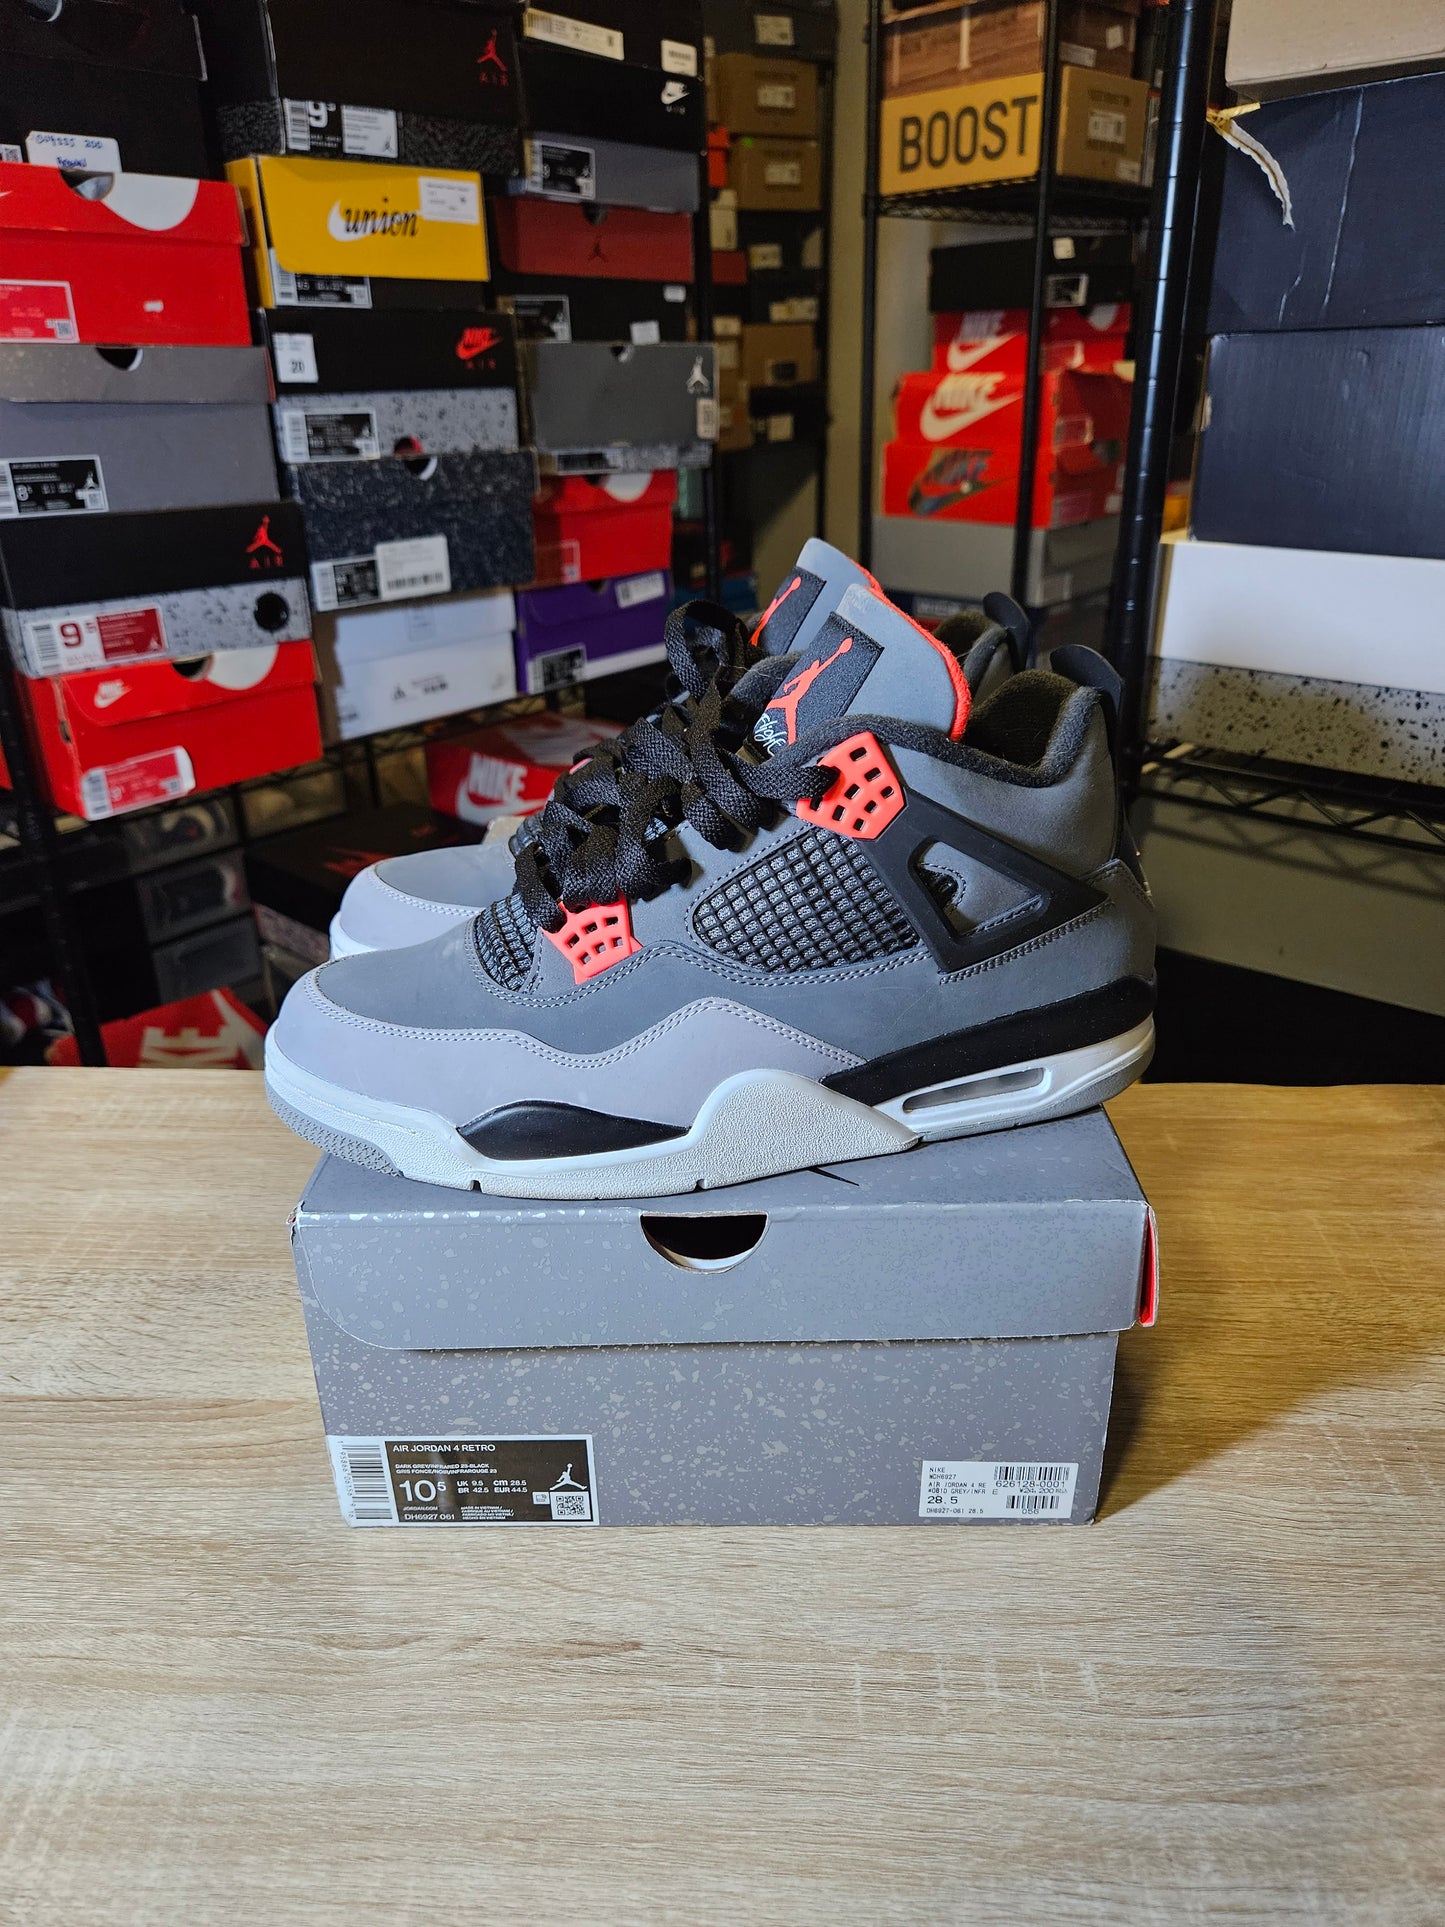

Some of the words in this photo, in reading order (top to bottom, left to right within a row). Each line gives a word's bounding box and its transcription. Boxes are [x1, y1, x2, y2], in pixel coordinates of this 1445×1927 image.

[899, 95, 1038, 173] BOOST
[345, 198, 418, 236] union
[933, 371, 1006, 411] NIKE
[468, 752, 528, 805] NIKE
[392, 1444, 409, 1452] AIR
[411, 1444, 451, 1452] JORDAN
[453, 1444, 460, 1452] 4
[462, 1444, 496, 1452] RETRO
[927, 1496, 958, 1504] 28.5
